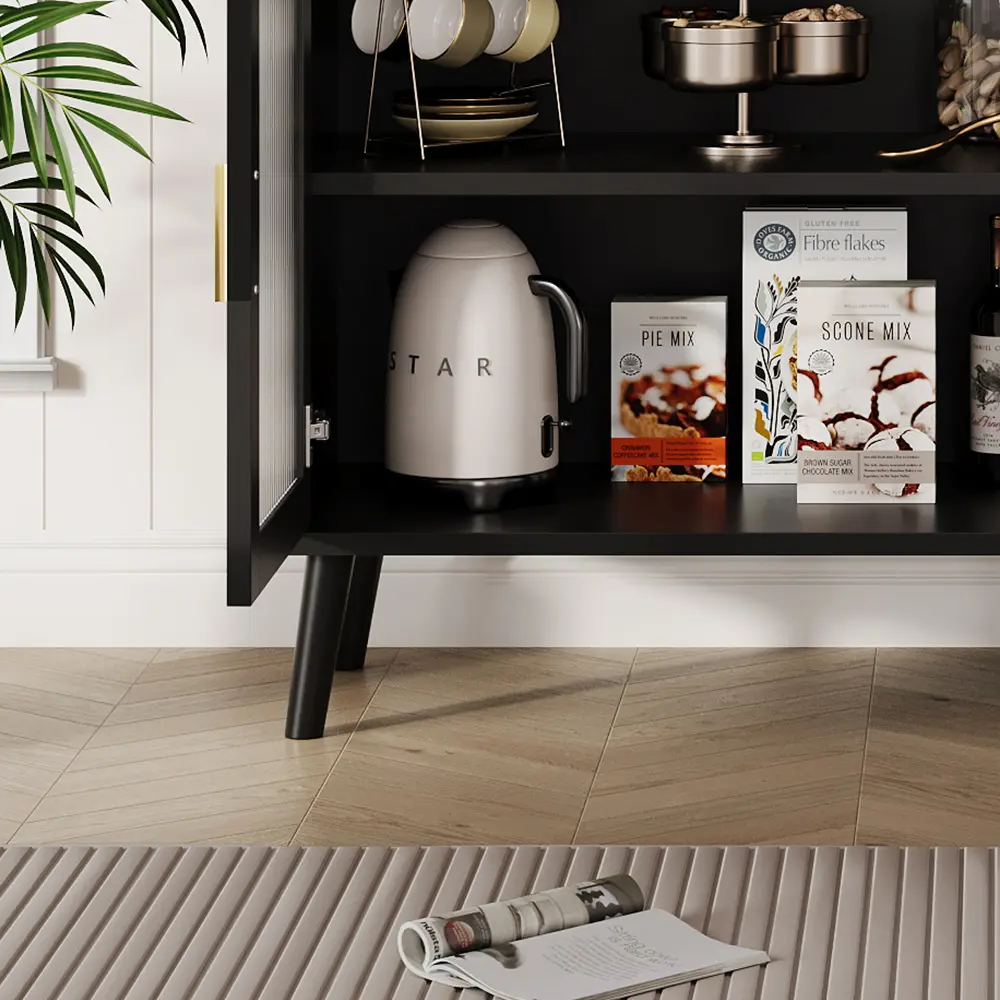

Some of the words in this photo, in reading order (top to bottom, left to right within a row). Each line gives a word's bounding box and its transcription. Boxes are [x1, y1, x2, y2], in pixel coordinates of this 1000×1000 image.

[755, 225, 777, 246] DOVES
[777, 225, 793, 245] FARM
[803, 233, 840, 251] Fibre
[844, 233, 886, 251] flakes
[757, 245, 793, 260] ORGANIC
[641, 330, 663, 347] PIE
[670, 330, 695, 347] MIX
[821, 321, 875, 341] SCONE
[883, 321, 912, 341] MIX
[801, 467, 840, 476] CHOCOLATE
[803, 459, 829, 467] BROWN
[829, 459, 852, 467] SUGAR
